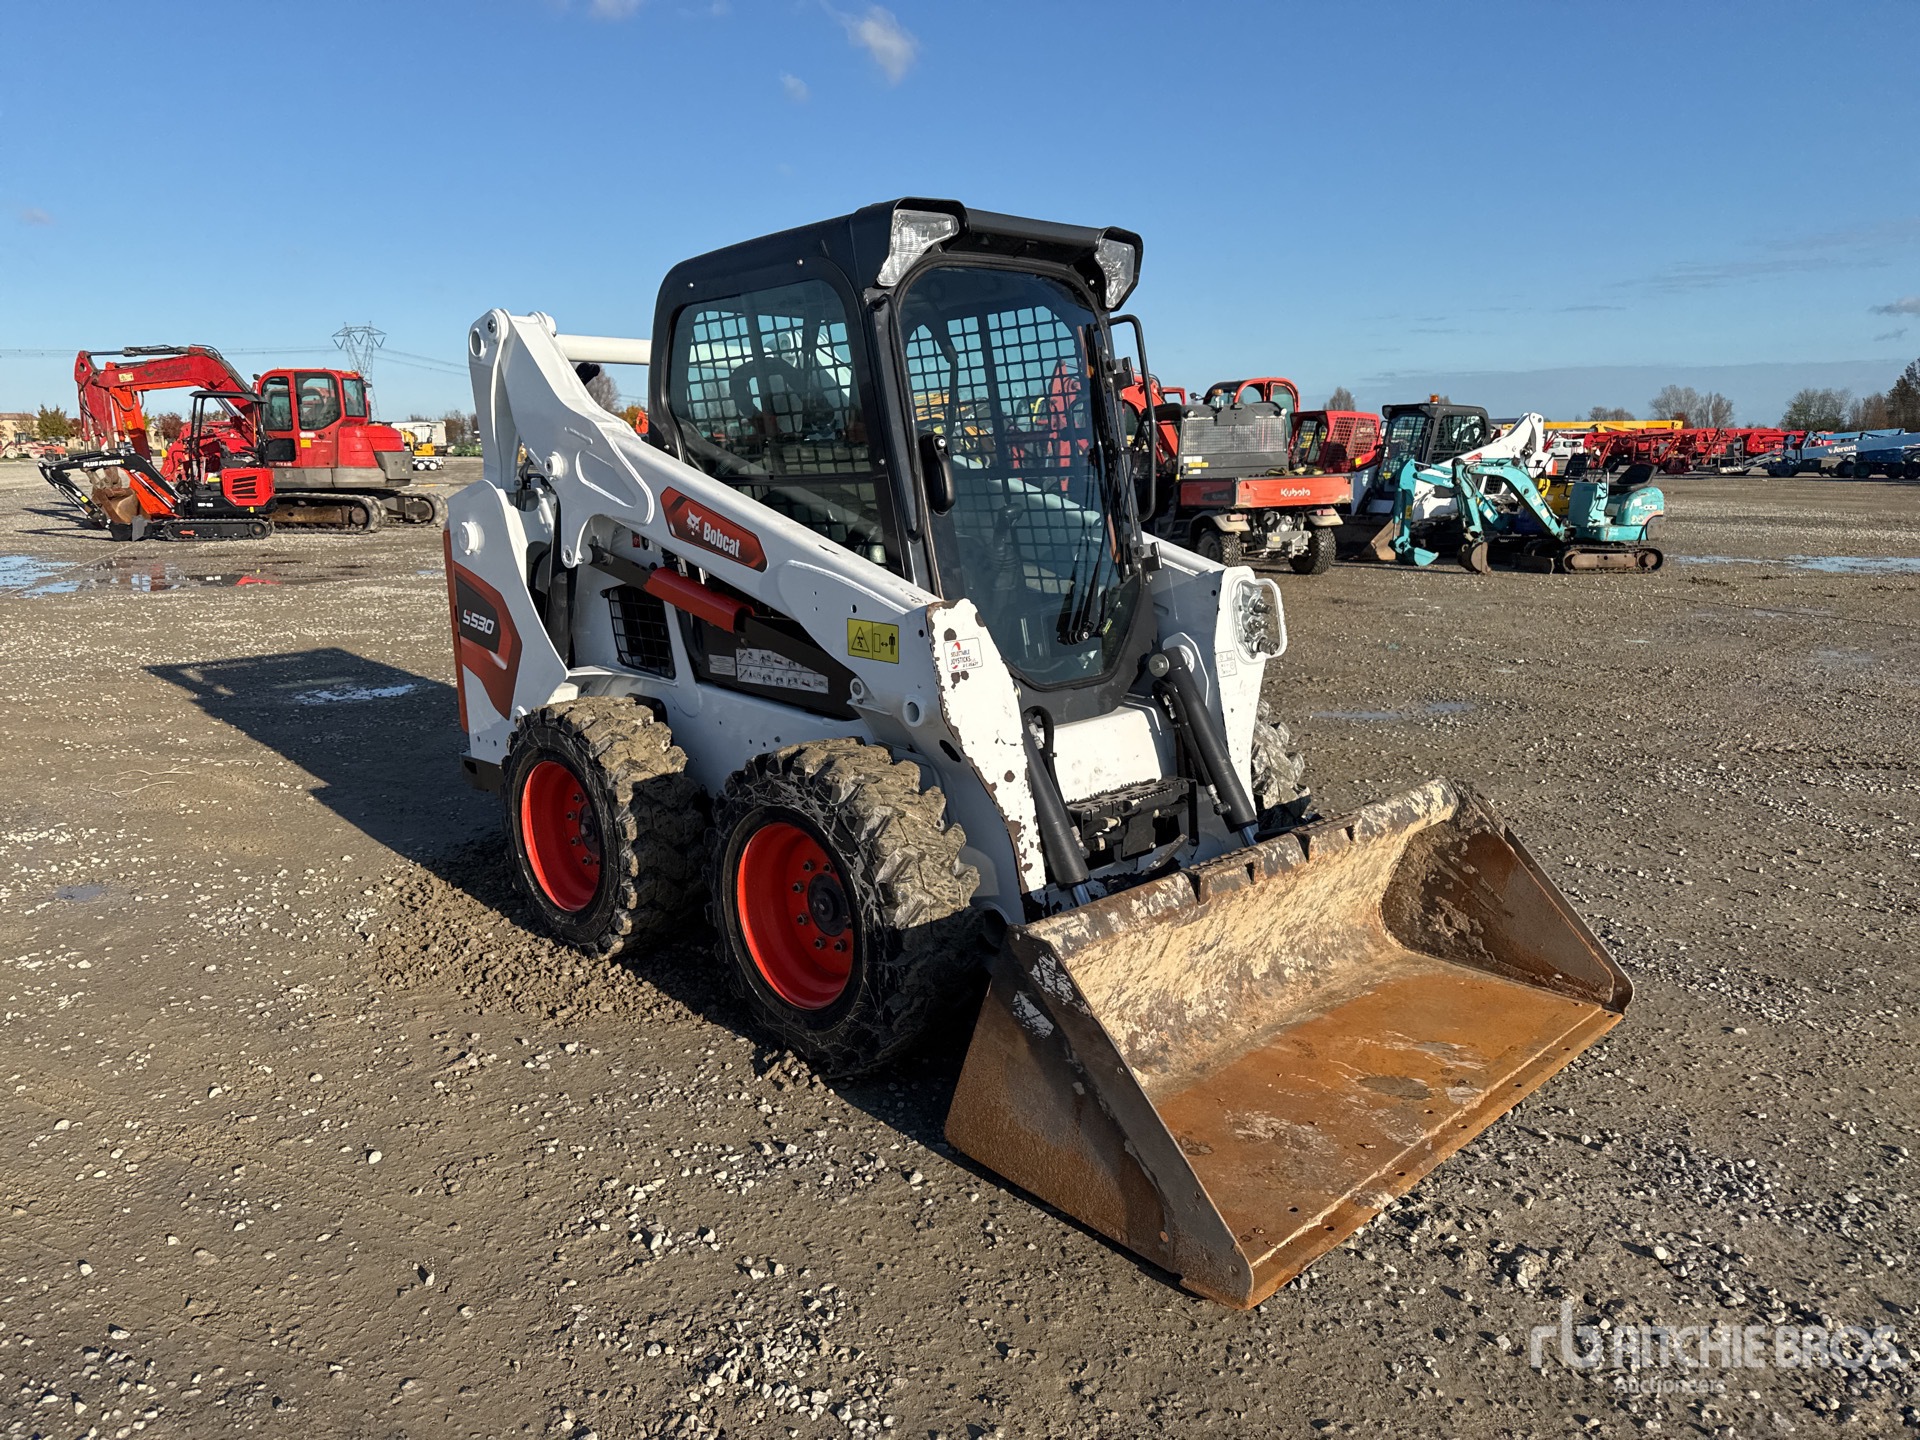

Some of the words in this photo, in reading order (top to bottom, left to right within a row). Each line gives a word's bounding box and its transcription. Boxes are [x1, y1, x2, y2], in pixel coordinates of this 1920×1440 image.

[1280, 487, 1311, 497] Kubota
[703, 521, 740, 558] Bobcat
[462, 609, 495, 635] S530
